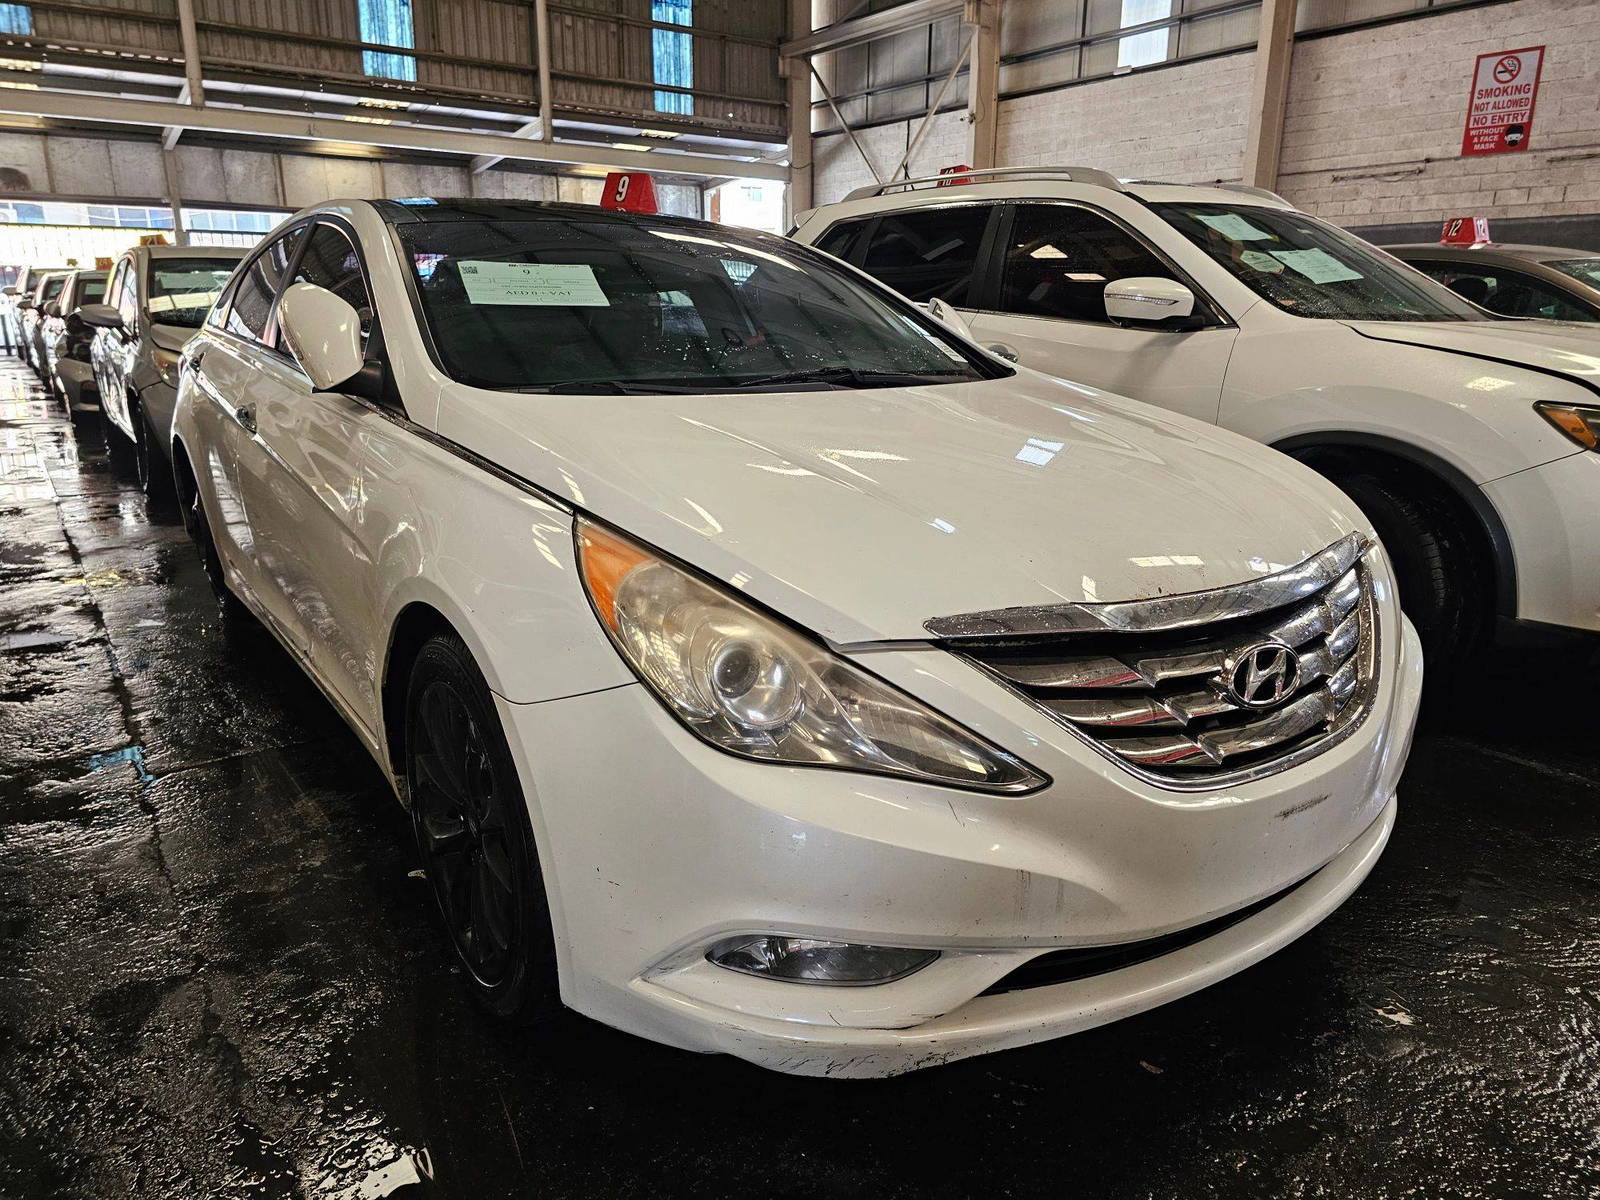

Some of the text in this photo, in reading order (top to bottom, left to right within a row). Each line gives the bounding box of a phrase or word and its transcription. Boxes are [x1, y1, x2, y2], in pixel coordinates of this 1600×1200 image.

[1476, 83, 1531, 100] SMOKING
[1473, 97, 1530, 113] NOT ALLOWED
[1472, 111, 1527, 127] NO ENTRY
[1469, 127, 1505, 137] WITHOUT
[1473, 142, 1496, 151] MASK
[615, 175, 630, 202] 9
[1447, 219, 1463, 237] 12
